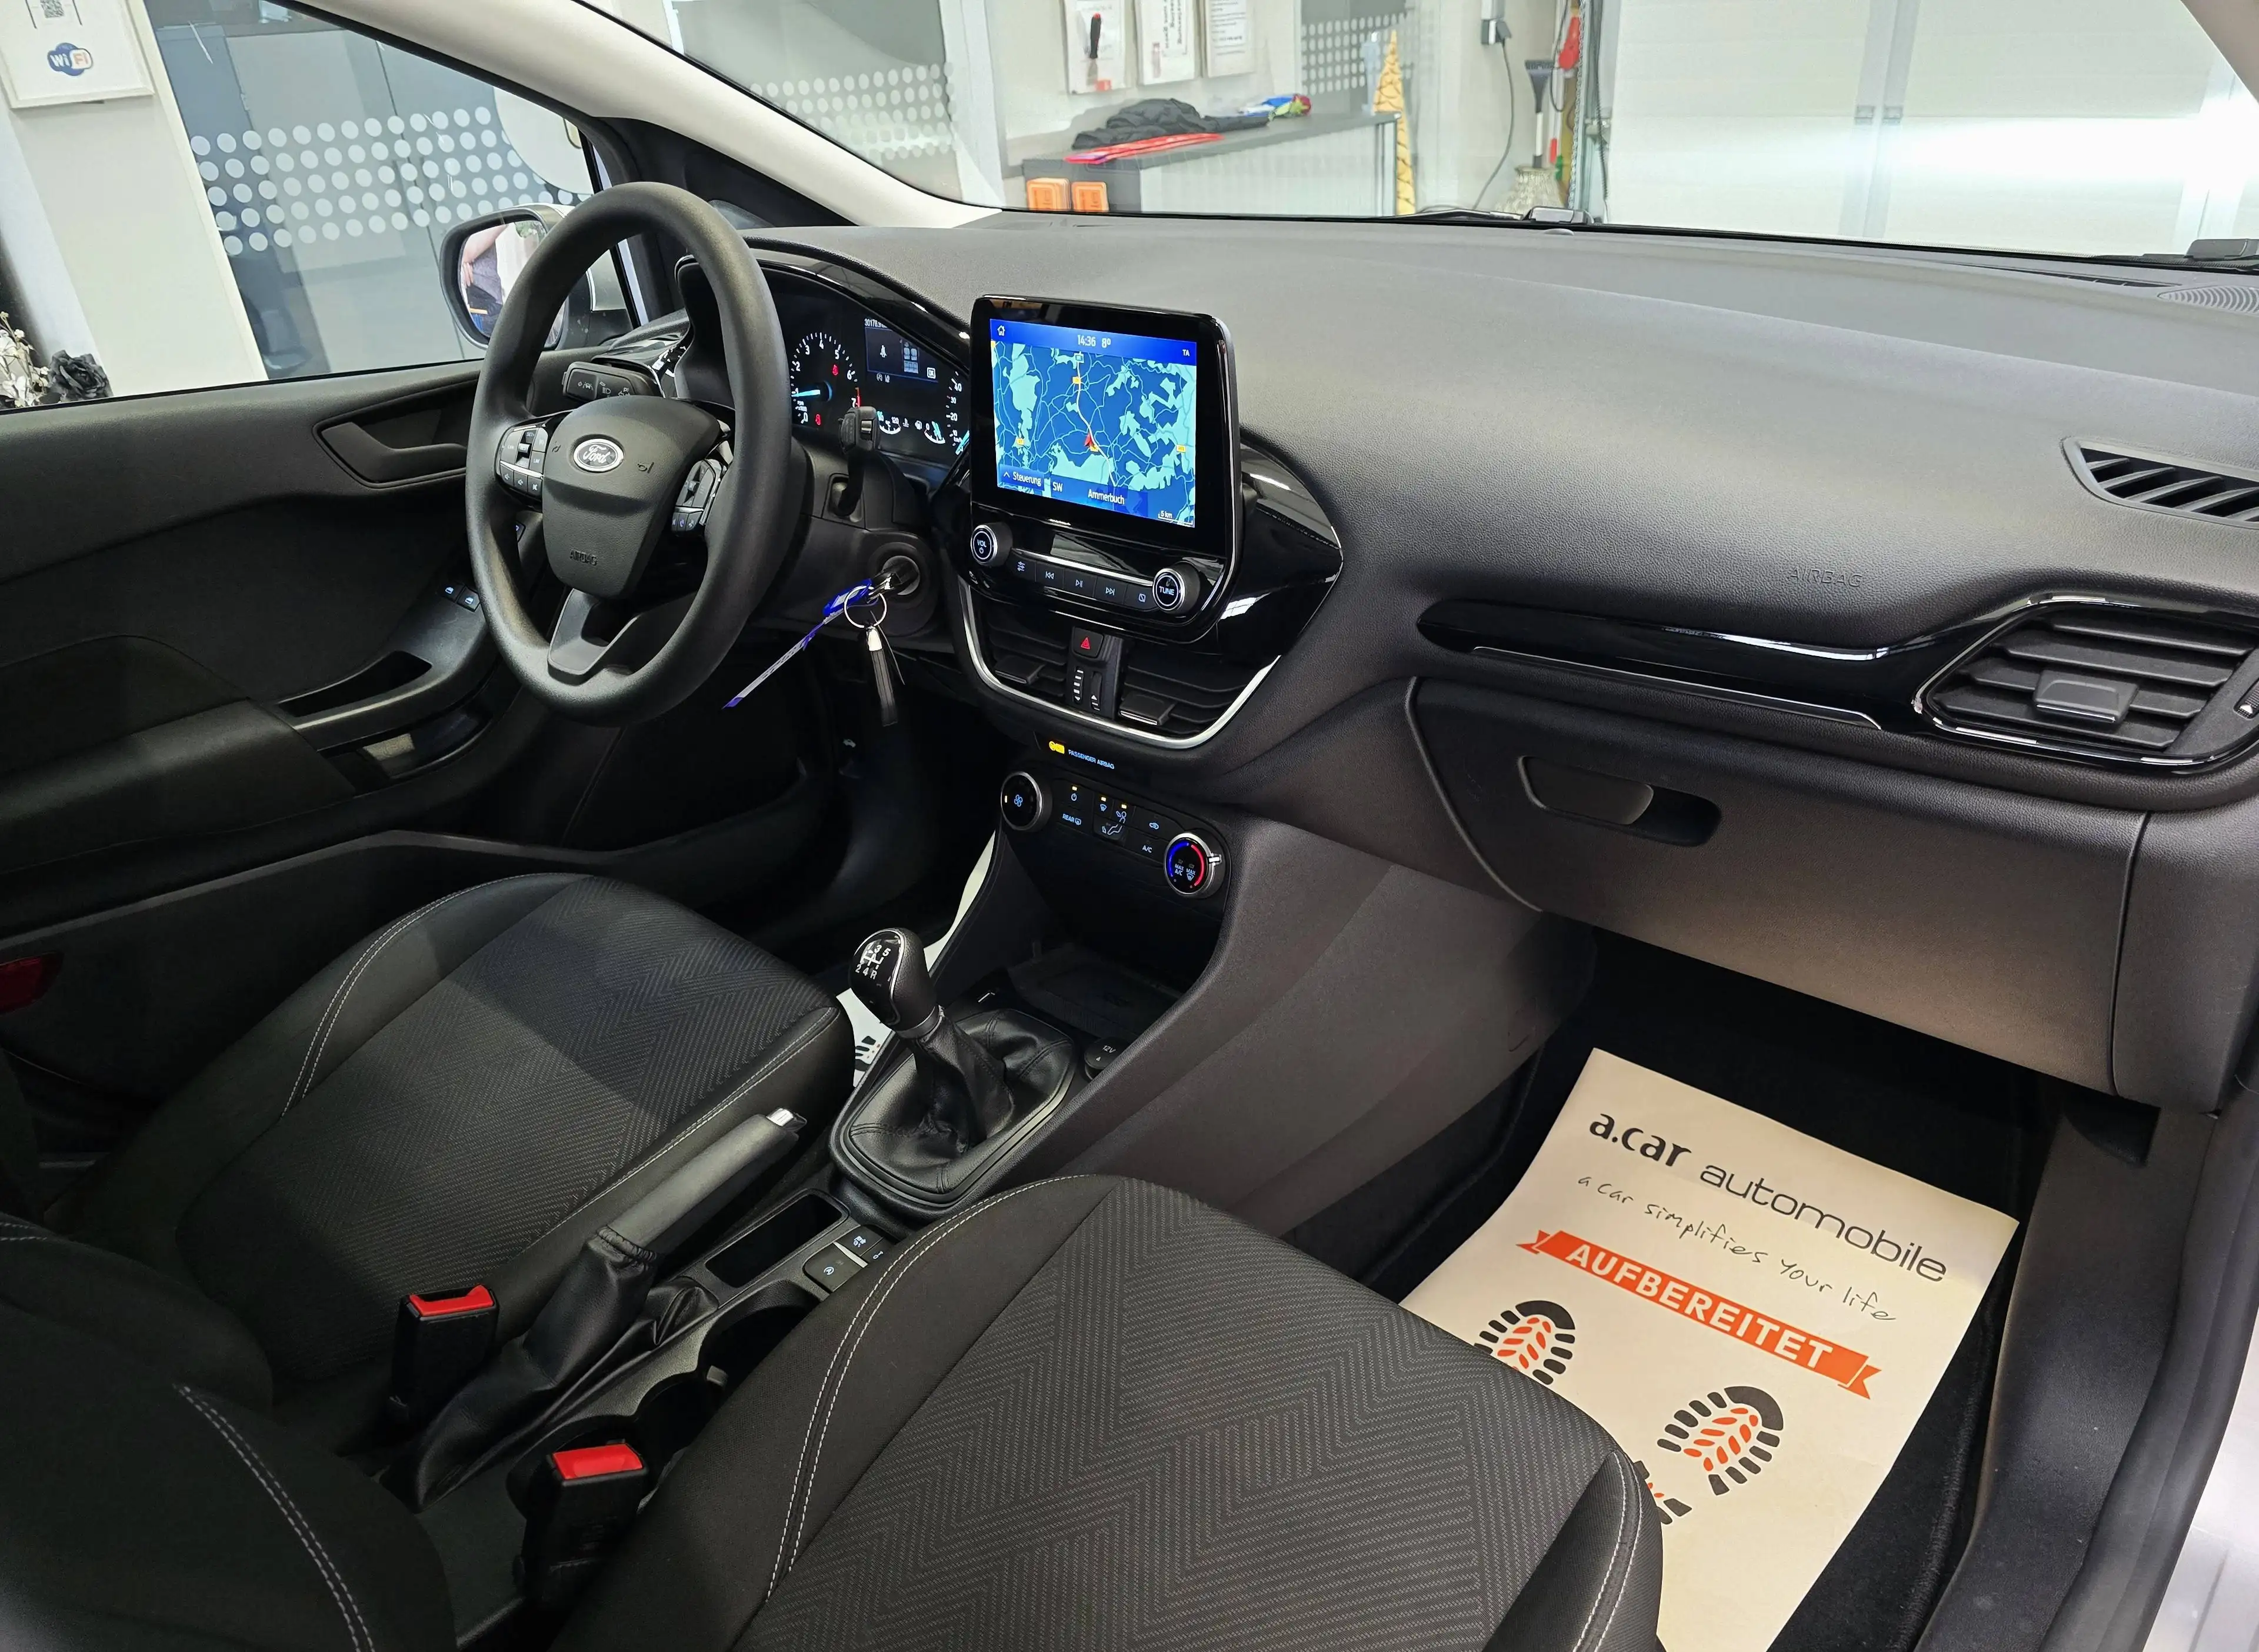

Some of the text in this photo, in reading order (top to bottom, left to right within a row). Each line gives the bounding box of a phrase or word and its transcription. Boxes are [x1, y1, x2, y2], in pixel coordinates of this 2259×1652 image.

[819, 339, 824, 349] 4
[1077, 334, 1096, 347] 14:36
[805, 345, 810, 355] 3
[834, 349, 839, 359] 5
[795, 361, 801, 372] 2
[847, 369, 852, 380] 6
[954, 383, 962, 392] 40
[950, 396, 957, 404] 30
[950, 412, 958, 422] 20
[582, 444, 611, 463] Ford
[1012, 471, 1041, 487] Steuerung
[1052, 481, 1063, 492] SW
[1088, 488, 1125, 505] Ammerbuch
[977, 539, 987, 548] VOL
[569, 549, 598, 566] AIRBAG
[1788, 567, 1863, 587] AIRBAG
[1159, 586, 1175, 596] TUNE
[1068, 749, 1115, 770] PASSENGER AIRBAG
[1062, 814, 1074, 823] REAR
[1142, 845, 1152, 853] A/C
[874, 944, 882, 954] 3
[882, 947, 891, 957] 5
[855, 964, 878, 980] 2 4 R
[1102, 1045, 1116, 1053] 12V
[1589, 1113, 1947, 1283] a.car automobile
[1577, 1176, 1592, 1187] a
[1597, 1183, 1634, 1204] car
[1644, 1204, 1768, 1263] simplifies
[1842, 1286, 1897, 1321] life
[1565, 1243, 1834, 1370] AUFBEREITET
